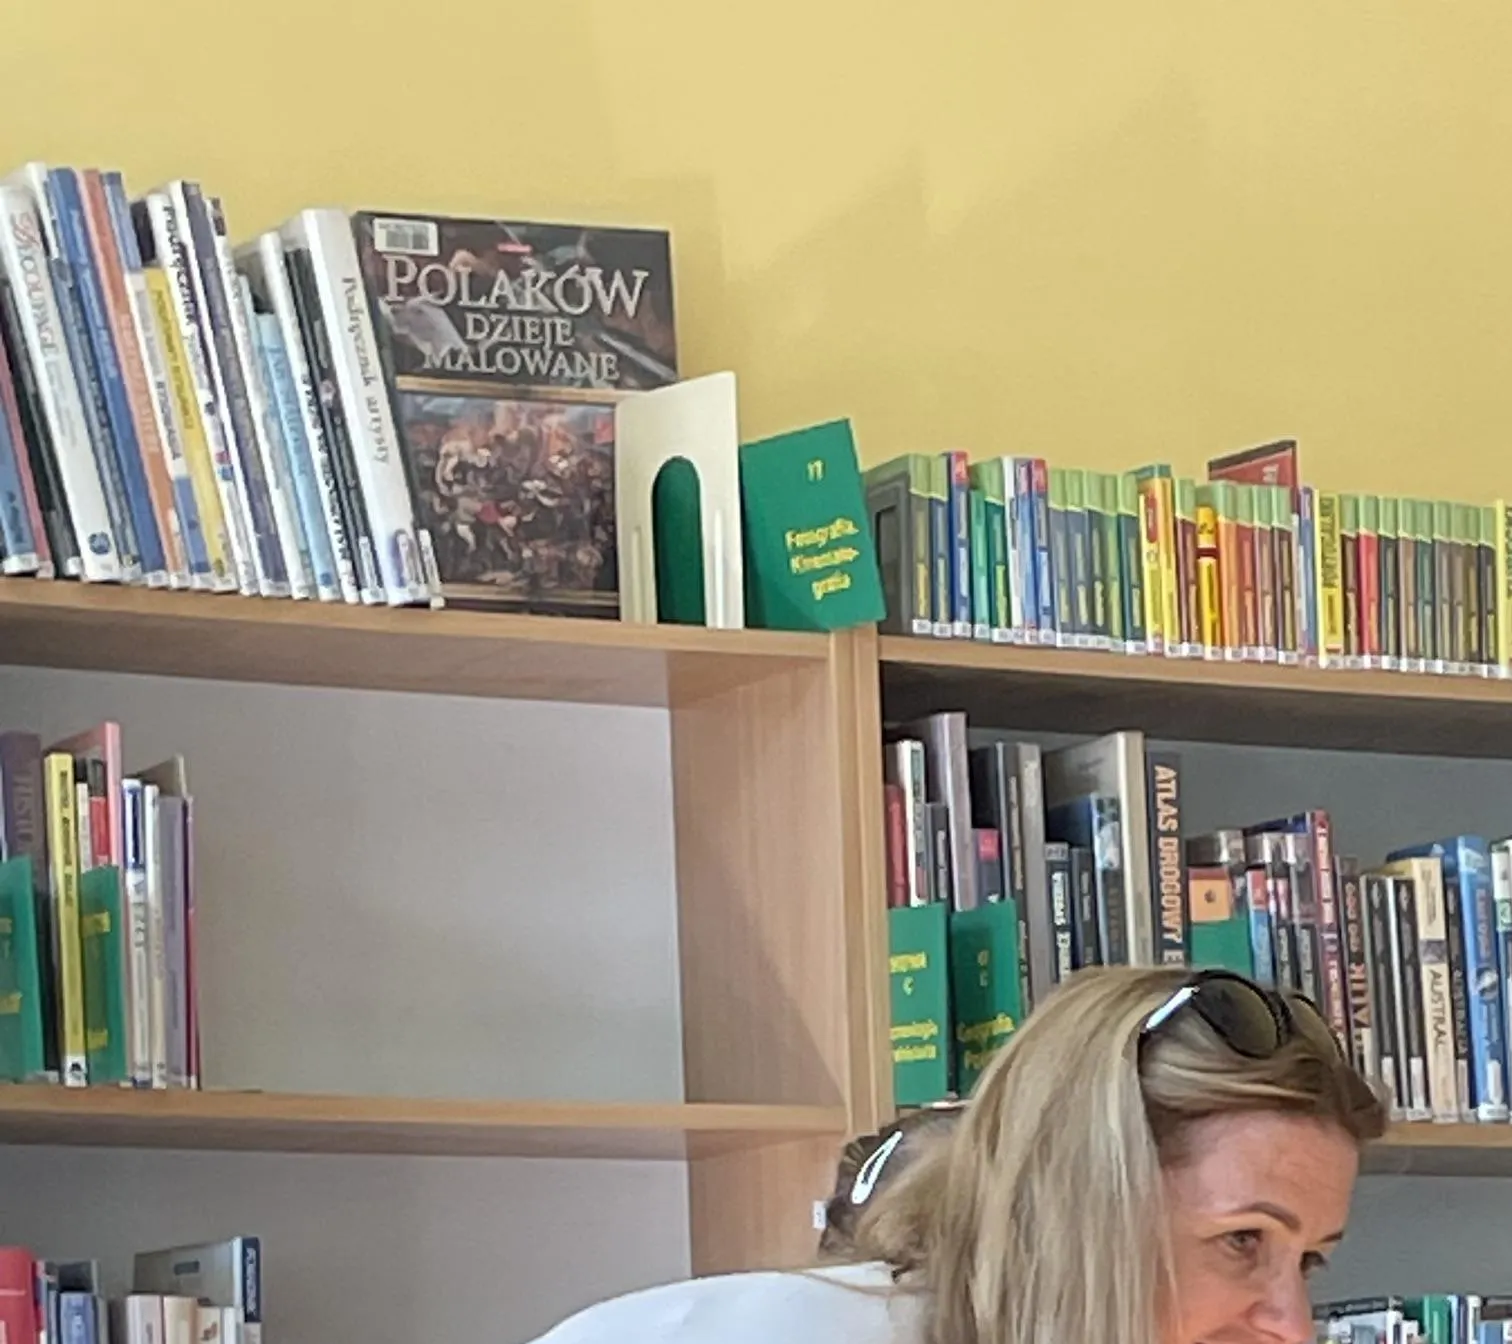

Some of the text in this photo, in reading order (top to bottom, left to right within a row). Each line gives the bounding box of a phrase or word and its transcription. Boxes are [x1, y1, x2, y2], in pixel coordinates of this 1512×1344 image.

[383, 254, 649, 318] POLAKÓW
[466, 312, 576, 346] DZIEJE
[341, 277, 391, 465] Podręcznik artysty
[422, 344, 620, 381] MALOWANE
[1154, 765, 1179, 833] ATLAS
[1157, 837, 1183, 945] DROGOWY
